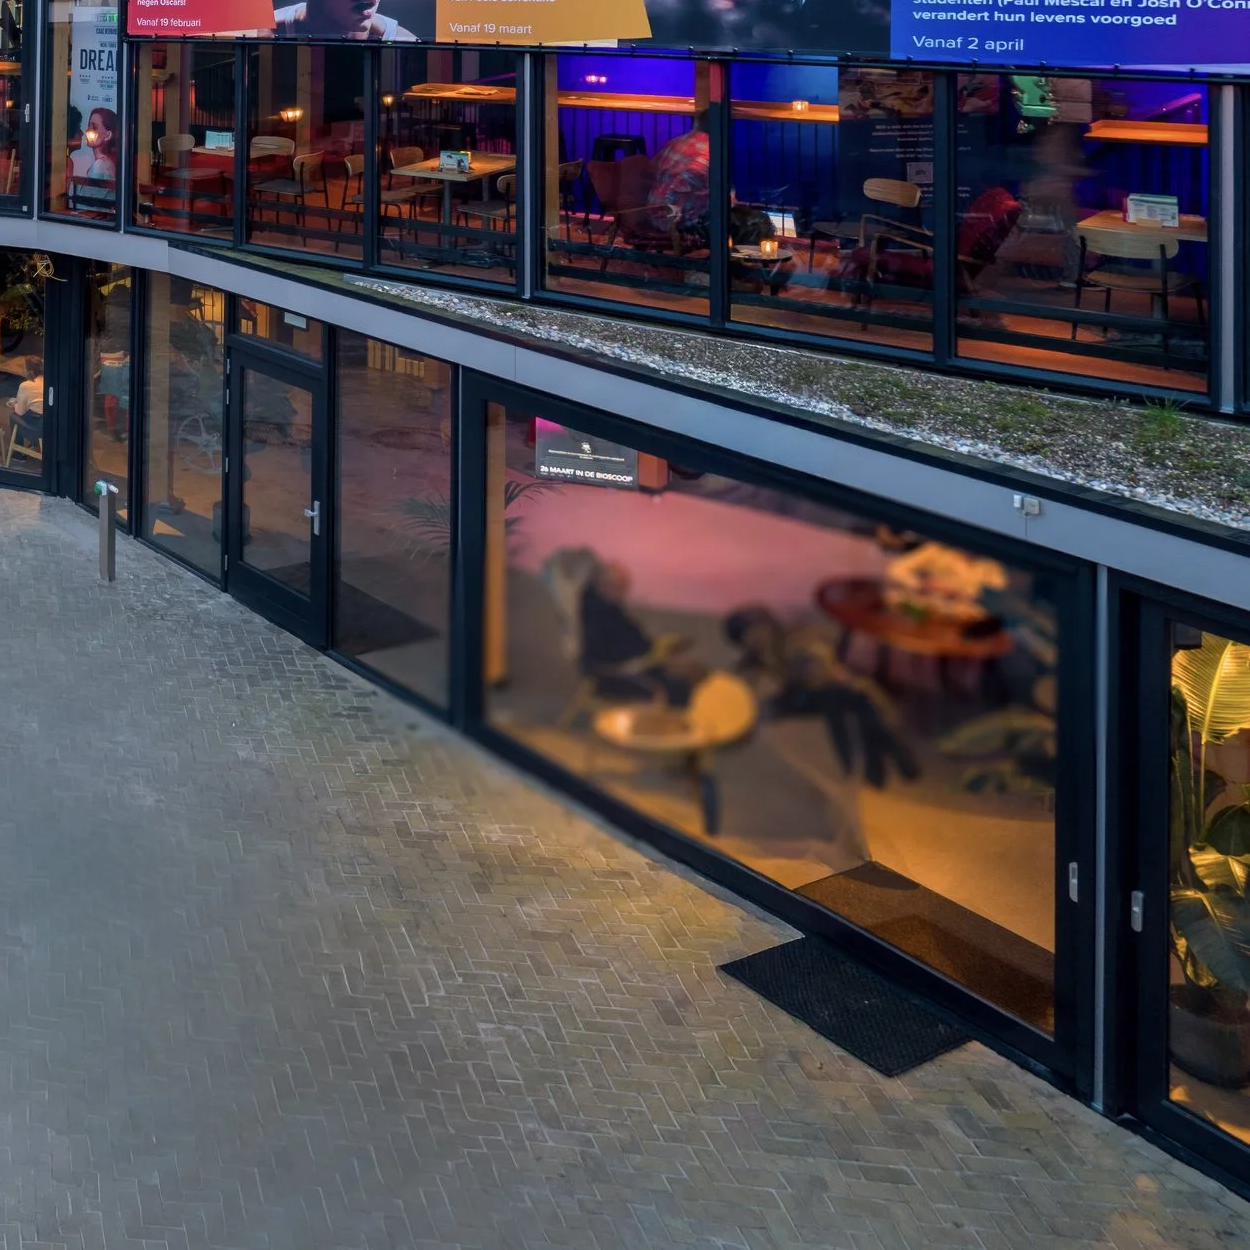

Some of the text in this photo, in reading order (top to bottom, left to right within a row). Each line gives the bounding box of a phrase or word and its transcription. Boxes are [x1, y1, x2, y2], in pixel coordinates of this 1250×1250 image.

[137, 0, 159, 7] negen
[136, 18, 201, 27] Vanaf 19 februari
[913, 10, 1177, 28] verandert hun levens voorgoed
[449, 22, 532, 34] Vanaf 19 maart
[912, 35, 1024, 53] Vanaf 2 april
[80, 48, 118, 72] DREA
[549, 466, 574, 475] MAART
[596, 472, 633, 482] BIOSCOOP
